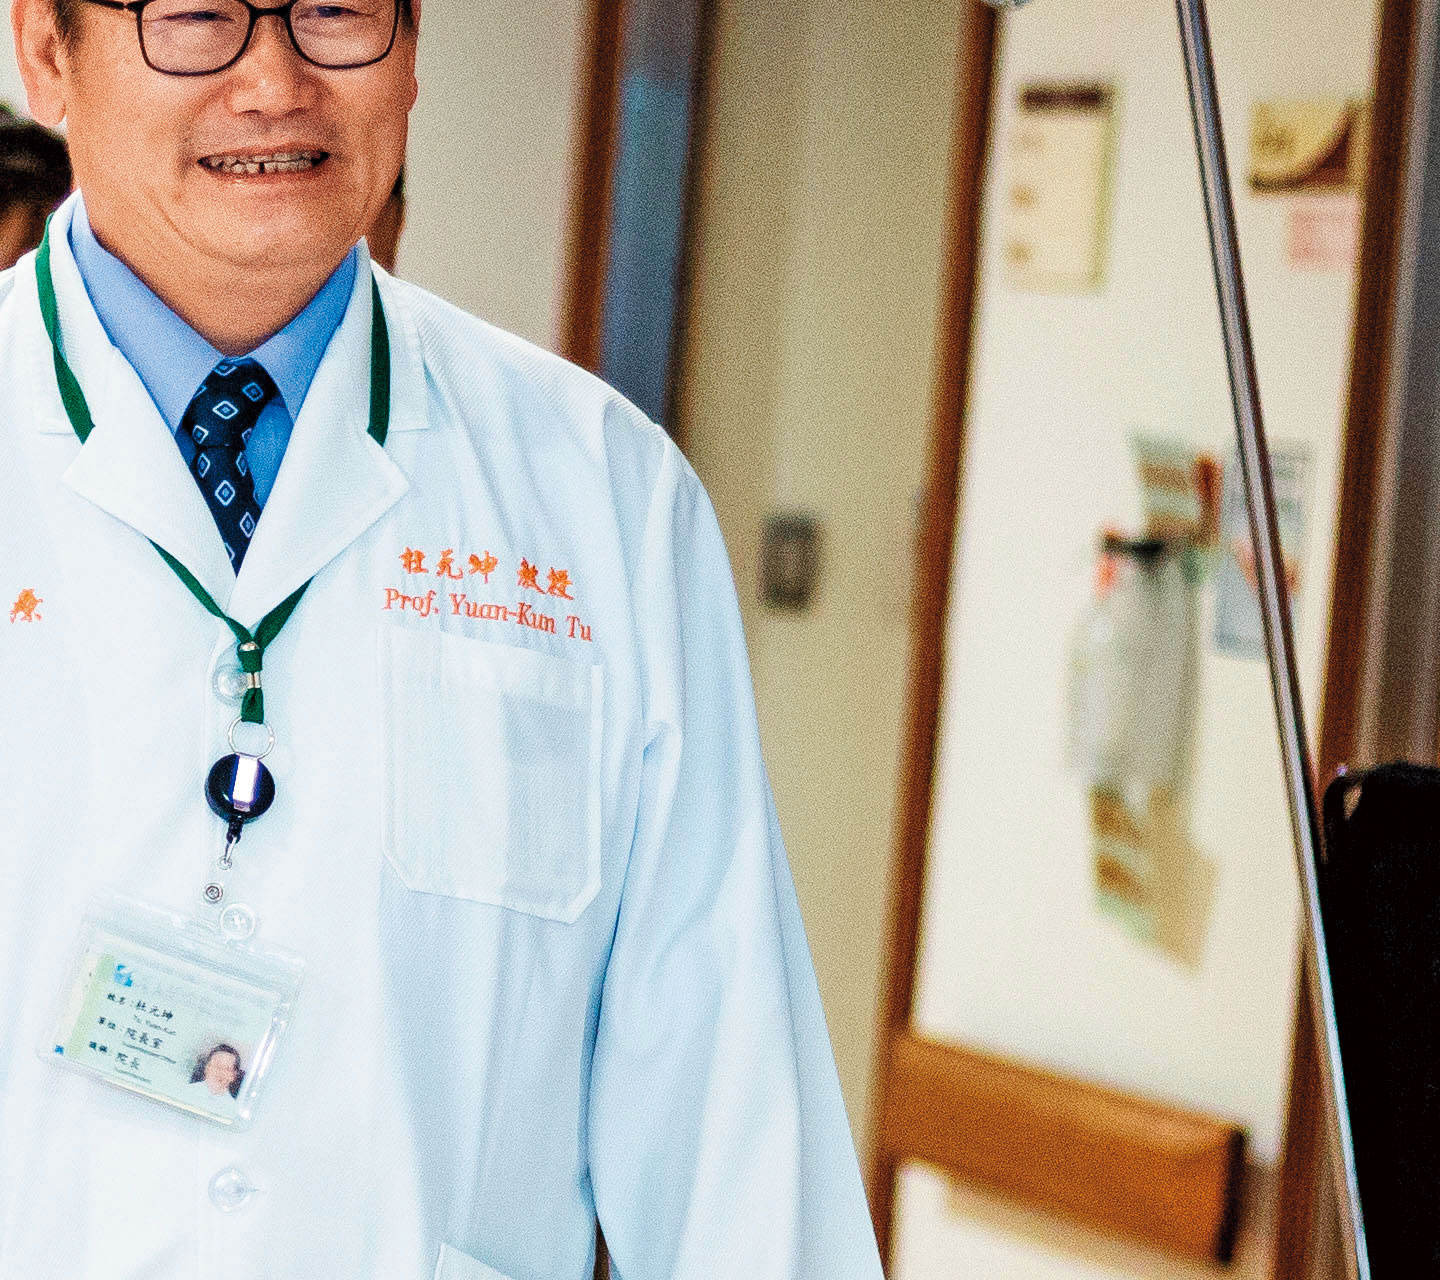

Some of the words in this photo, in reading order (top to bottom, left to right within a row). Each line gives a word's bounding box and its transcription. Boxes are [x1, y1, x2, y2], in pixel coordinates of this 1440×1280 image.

[398, 546, 499, 584] 杜元坤
[382, 587, 439, 618] Prof.
[448, 592, 557, 634] Yuan-Kun
[565, 614, 593, 642] Tu
